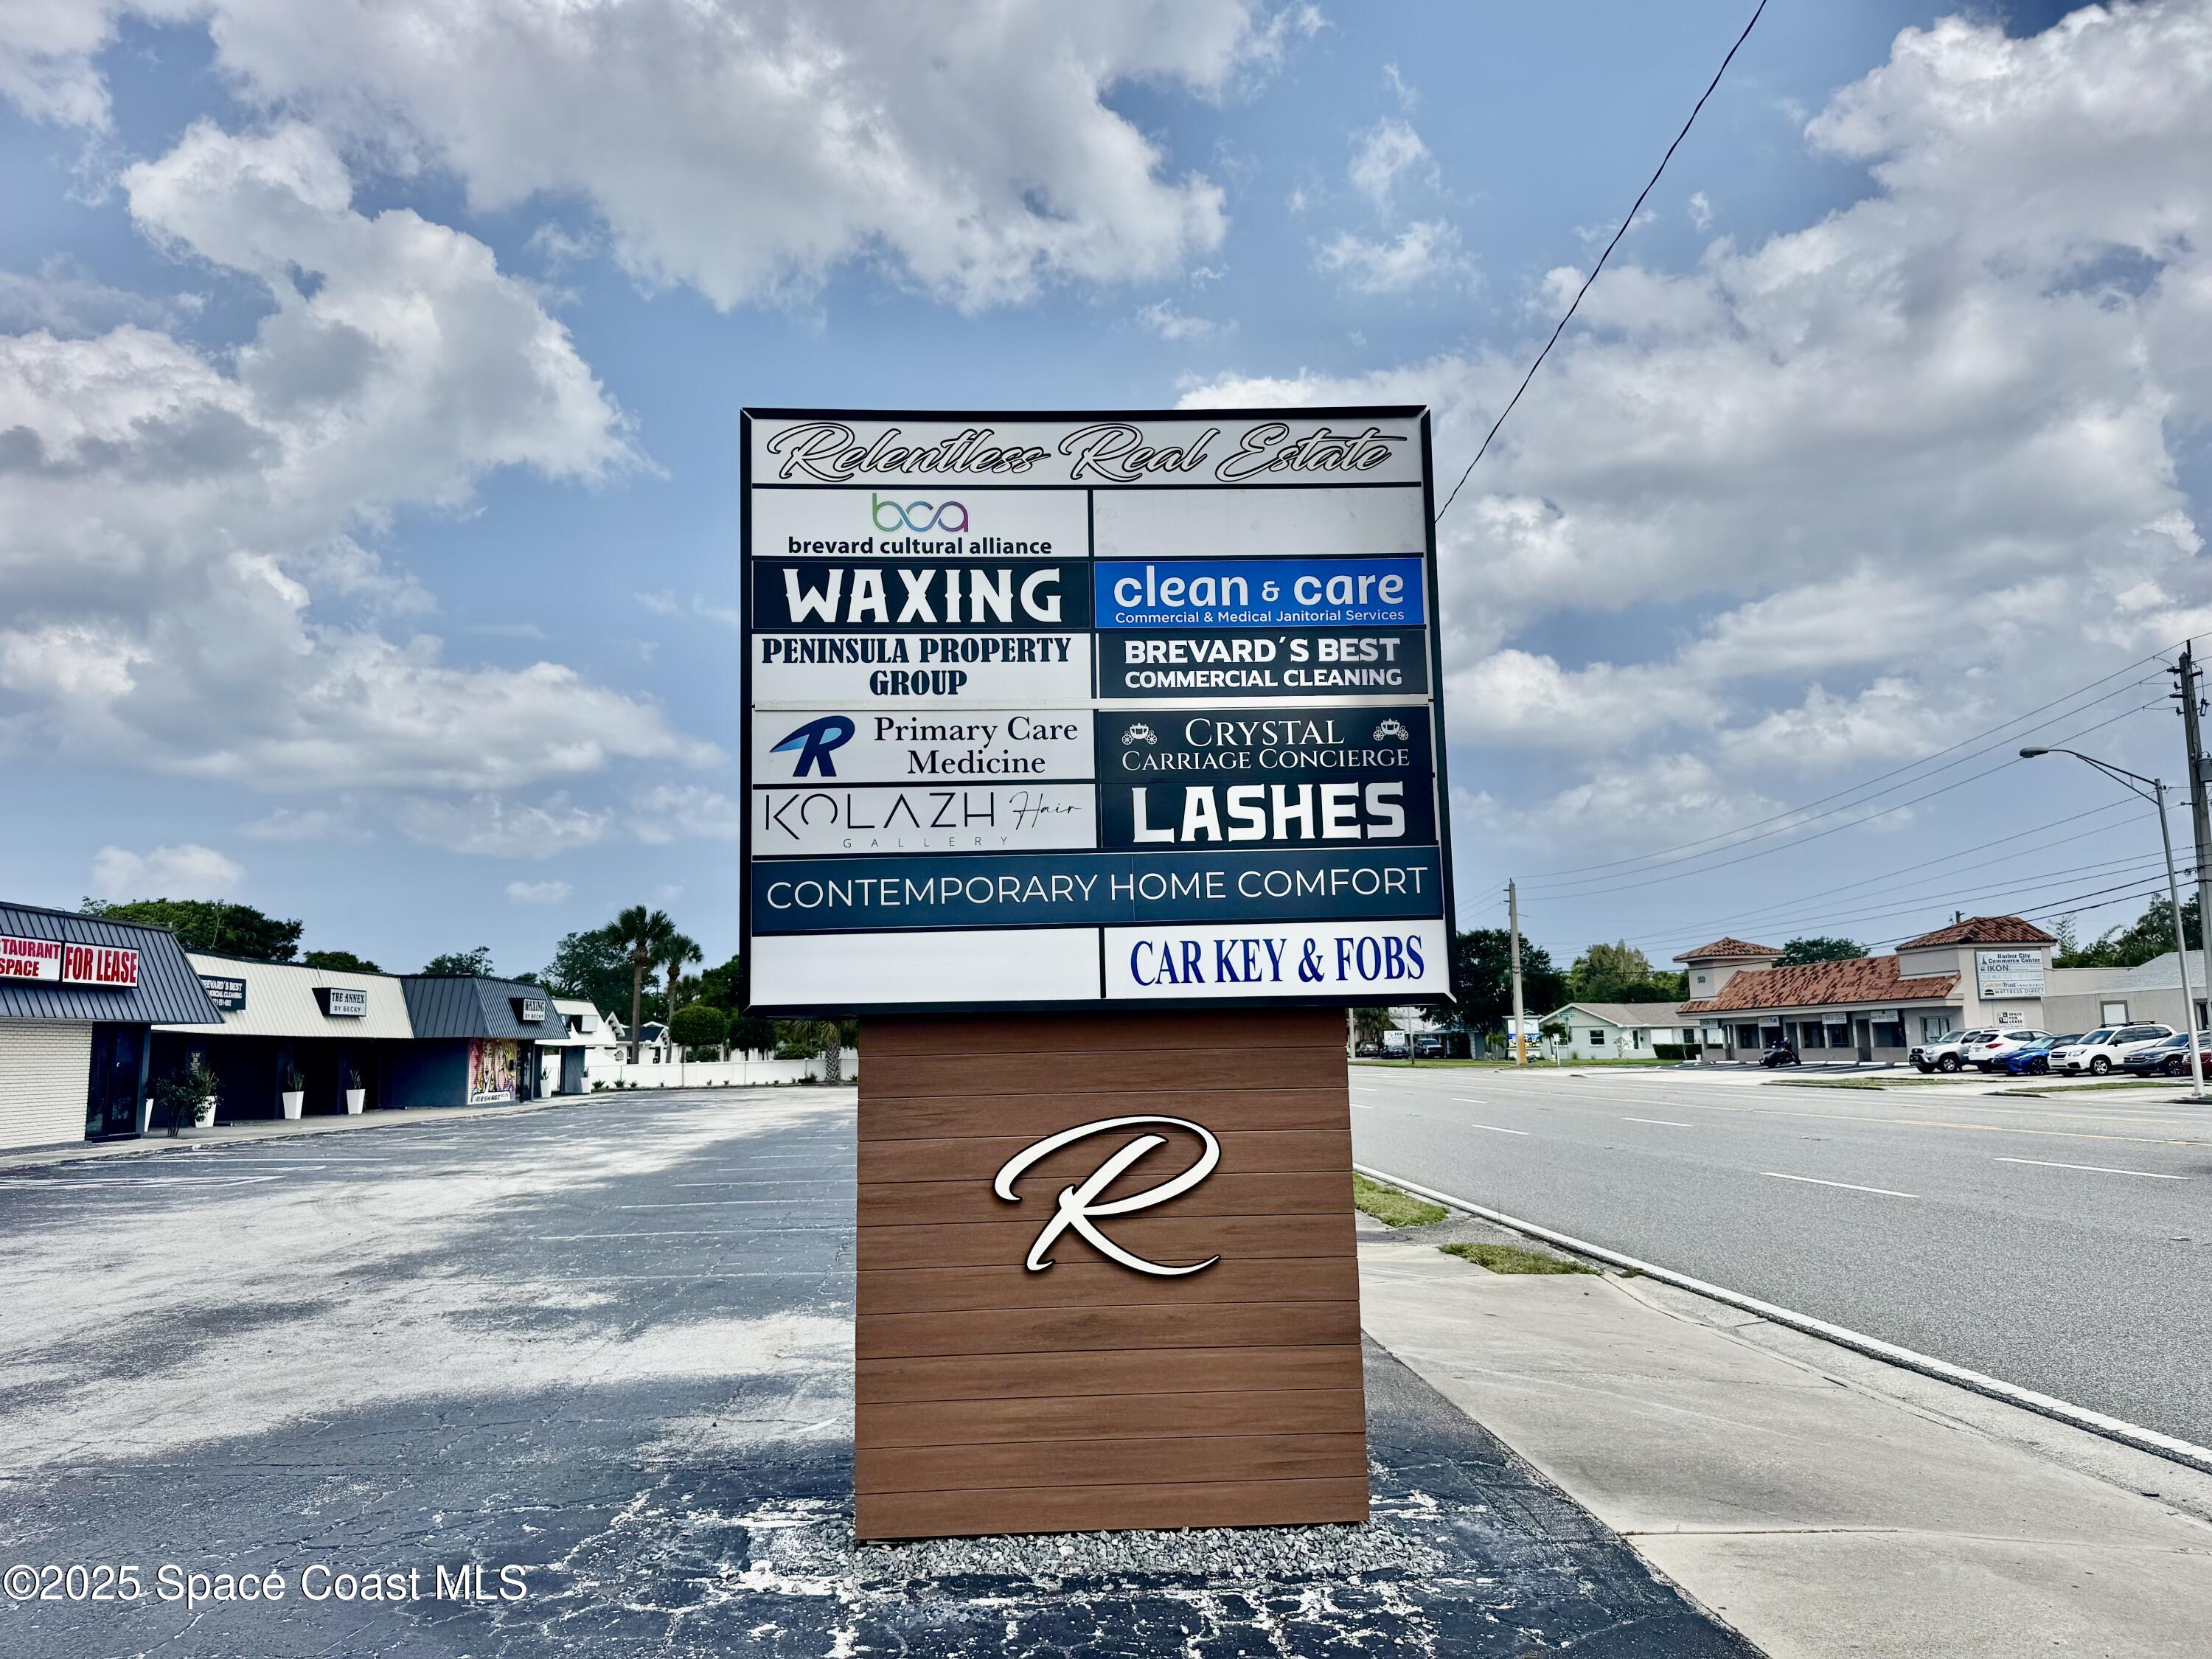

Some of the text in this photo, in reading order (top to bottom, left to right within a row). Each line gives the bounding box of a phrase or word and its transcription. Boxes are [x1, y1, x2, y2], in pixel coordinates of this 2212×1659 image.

[767, 422, 1407, 482] Relentless Real Estate
[872, 493, 968, 532] bca
[789, 537, 1052, 554] brevard cultural alliance
[783, 567, 1062, 623] WAXING
[1114, 565, 1404, 608] clean & care
[1116, 609, 1405, 624] Commercial & Medical Janitorial Services
[762, 637, 1071, 664] PENINSULA PROPERTY
[1318, 637, 1400, 661] BEST
[869, 669, 967, 695] GROUP
[1125, 668, 1402, 688] COMMERCIAL CLEANING
[874, 715, 1078, 748] Primary Care
[1185, 718, 1345, 747] CRYSTAL
[907, 749, 1046, 774] Medicine
[1121, 748, 1410, 771] CARRIAGE CONCIERGE
[765, 790, 1082, 840] KOLAZH Hair
[1131, 781, 1405, 843] LASHES
[843, 836, 1008, 848] GALLERY
[767, 866, 1428, 909] CONTEMPORARY HOME COMFORT
[0, 938, 60, 959] TAURANT
[1130, 935, 1425, 986] CAR KEY & FOBS
[63, 946, 138, 984] FOR LEASE
[229, 981, 243, 992] BEST
[332, 992, 365, 1004] THE ANNEX
[525, 1000, 545, 1012] WAXING
[994, 1113, 1221, 1276] R
